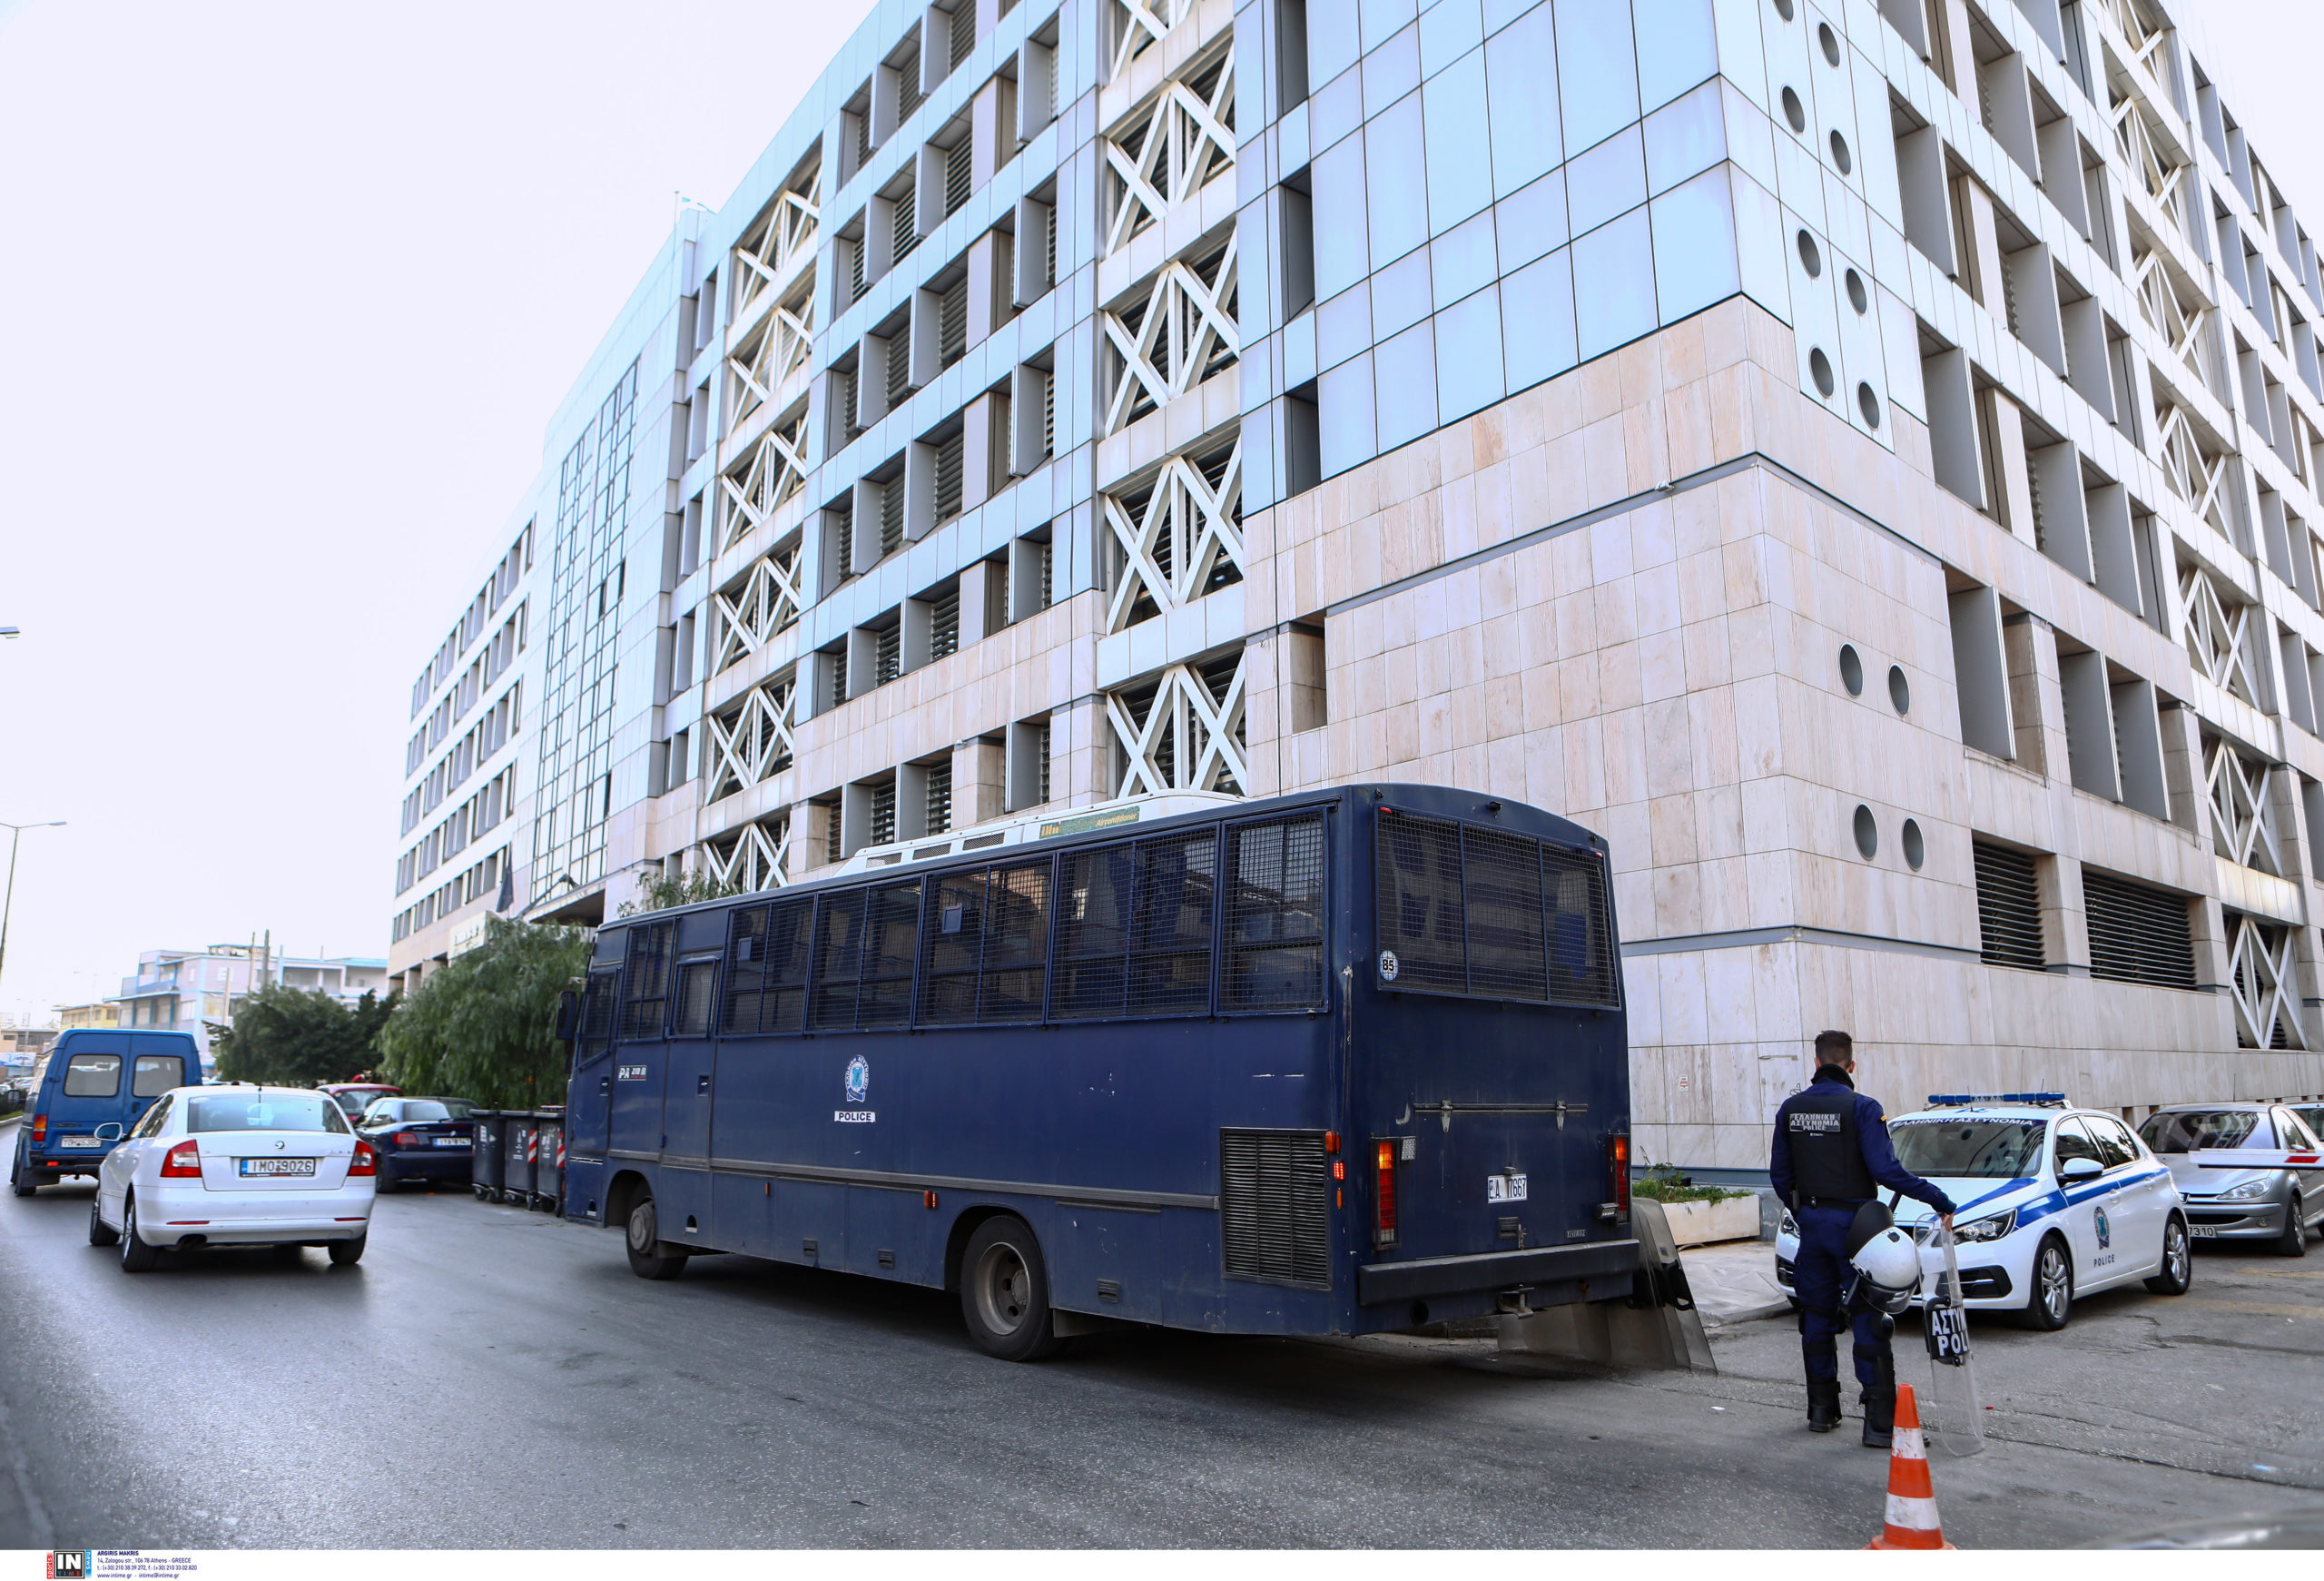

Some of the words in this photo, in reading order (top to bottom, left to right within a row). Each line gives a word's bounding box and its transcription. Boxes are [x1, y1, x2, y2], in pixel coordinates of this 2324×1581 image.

[1382, 959, 1394, 971] 85
[838, 1112, 872, 1122] POLICE
[1892, 1118, 1953, 1128] ΕΛΛΗΝΙΚΗ
[1955, 1118, 2034, 1126] ΑΣΤΥΝΟΜΙΑ
[2093, 1254, 2115, 1268] POLICE
